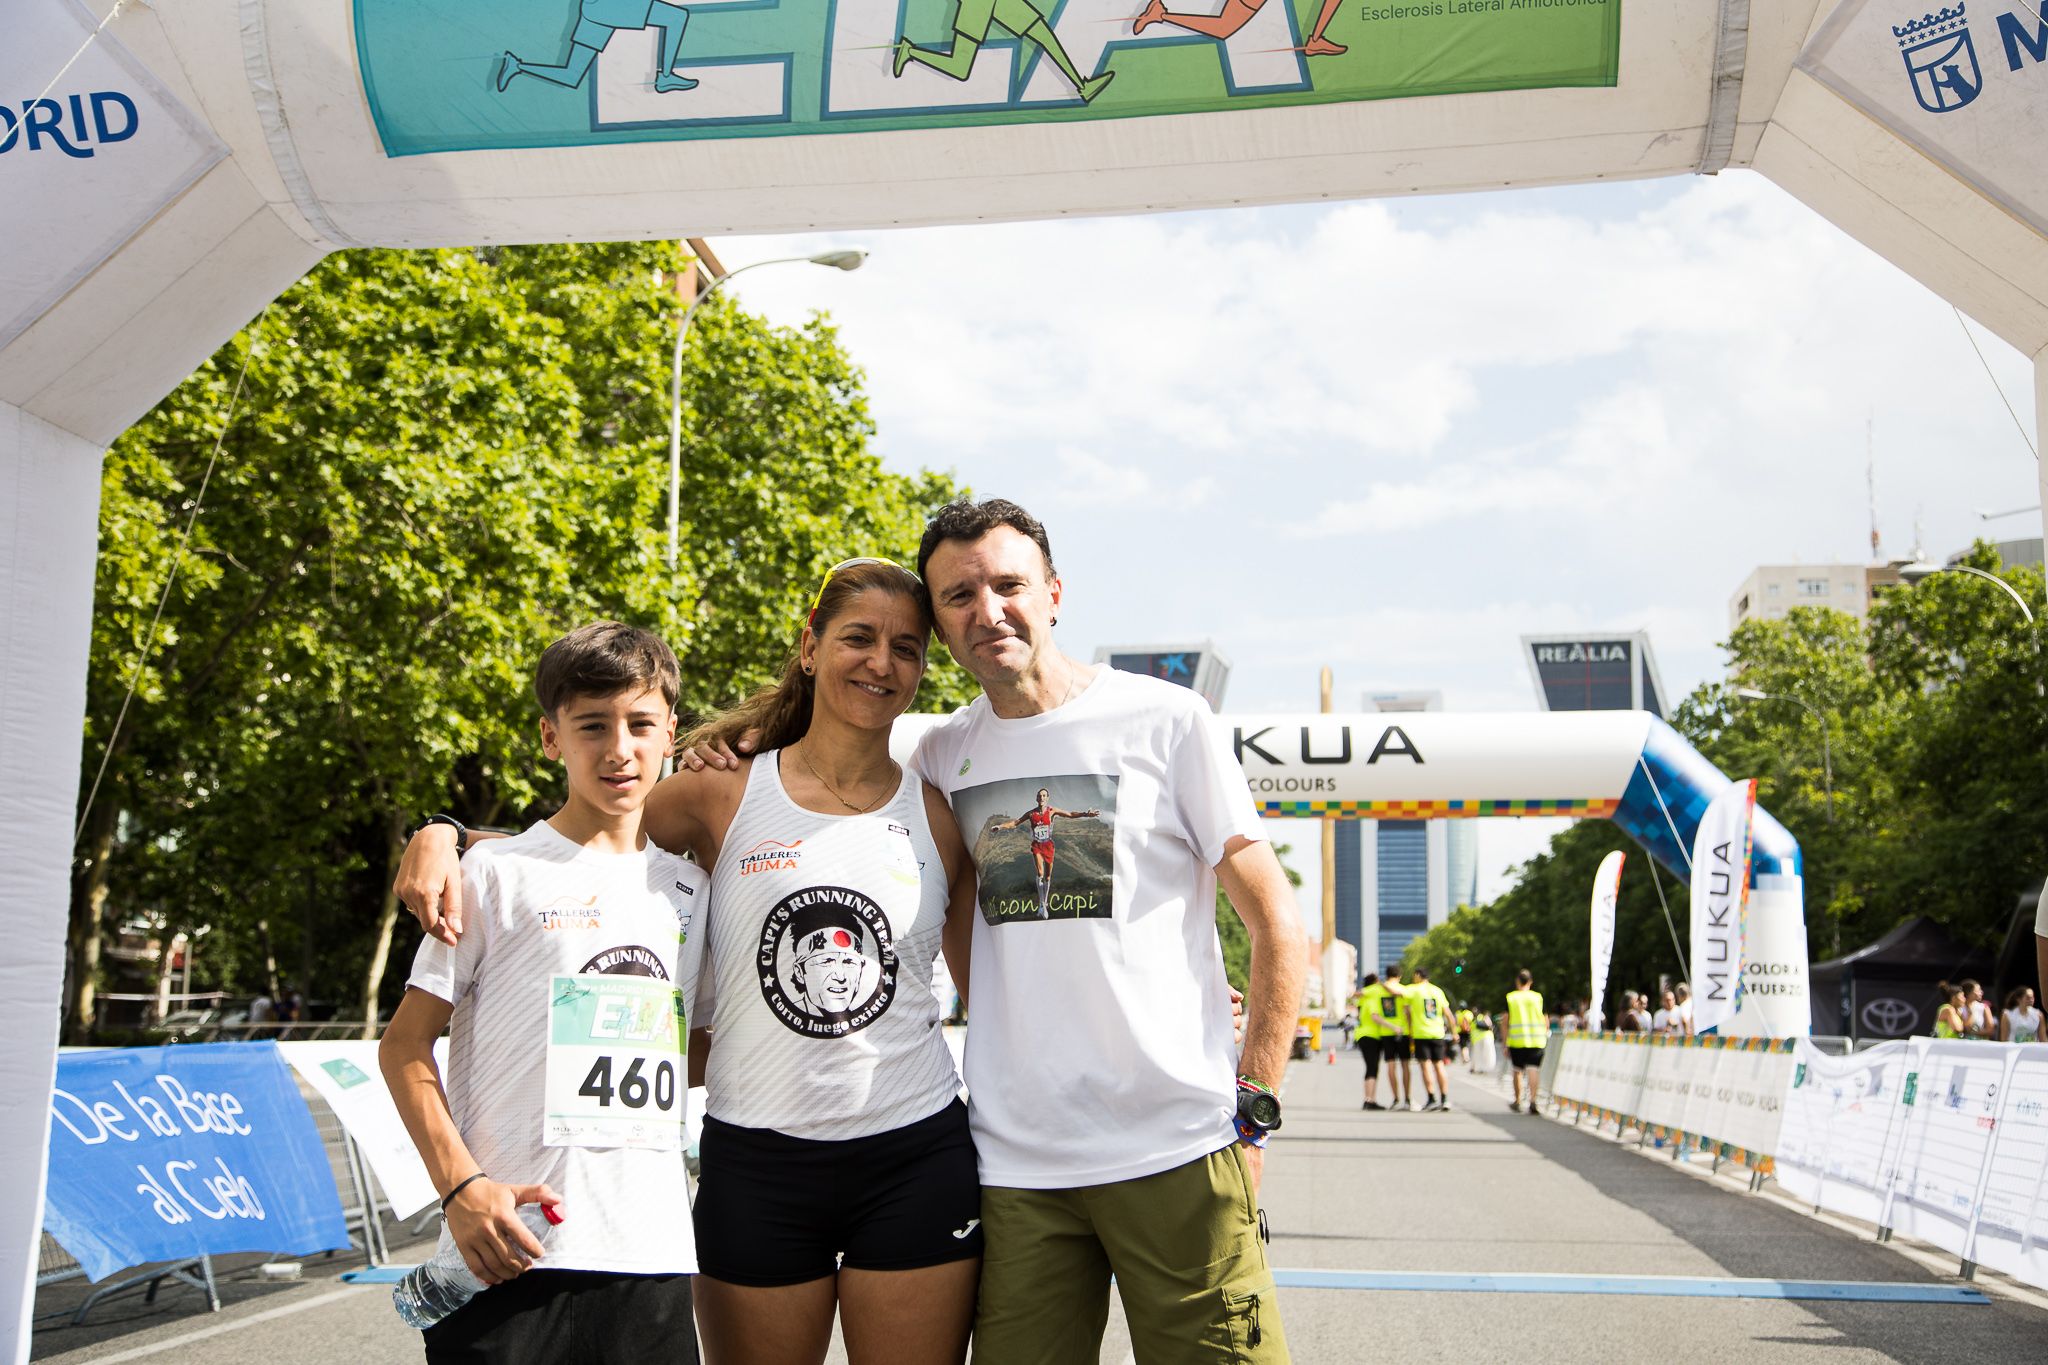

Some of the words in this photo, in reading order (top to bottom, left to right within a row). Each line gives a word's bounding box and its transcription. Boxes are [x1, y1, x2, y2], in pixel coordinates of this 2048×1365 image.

[1361, 2, 1443, 21] Esclerosis
[1448, 0, 1504, 15] Lateral
[1233, 725, 1425, 766] KUA
[1248, 778, 1337, 792] COLOURS
[740, 851, 801, 869] TALLERES
[741, 859, 797, 876] JUMA
[538, 909, 601, 923] TALLERES
[543, 918, 601, 930] JUMA
[1000, 899, 1038, 915] con
[1707, 841, 1731, 1000] MUKUA
[761, 907, 790, 966] CAPI'S
[787, 890, 877, 920] RUNNING
[589, 994, 673, 1043] ELA
[807, 1019, 850, 1035] luego
[850, 992, 889, 1027] existo
[578, 1056, 675, 1111] 460
[49, 1088, 139, 1144] De
[112, 1080, 181, 1136] la
[155, 1074, 252, 1136] Base
[136, 1164, 192, 1224] al
[166, 1156, 265, 1221] Cielo
